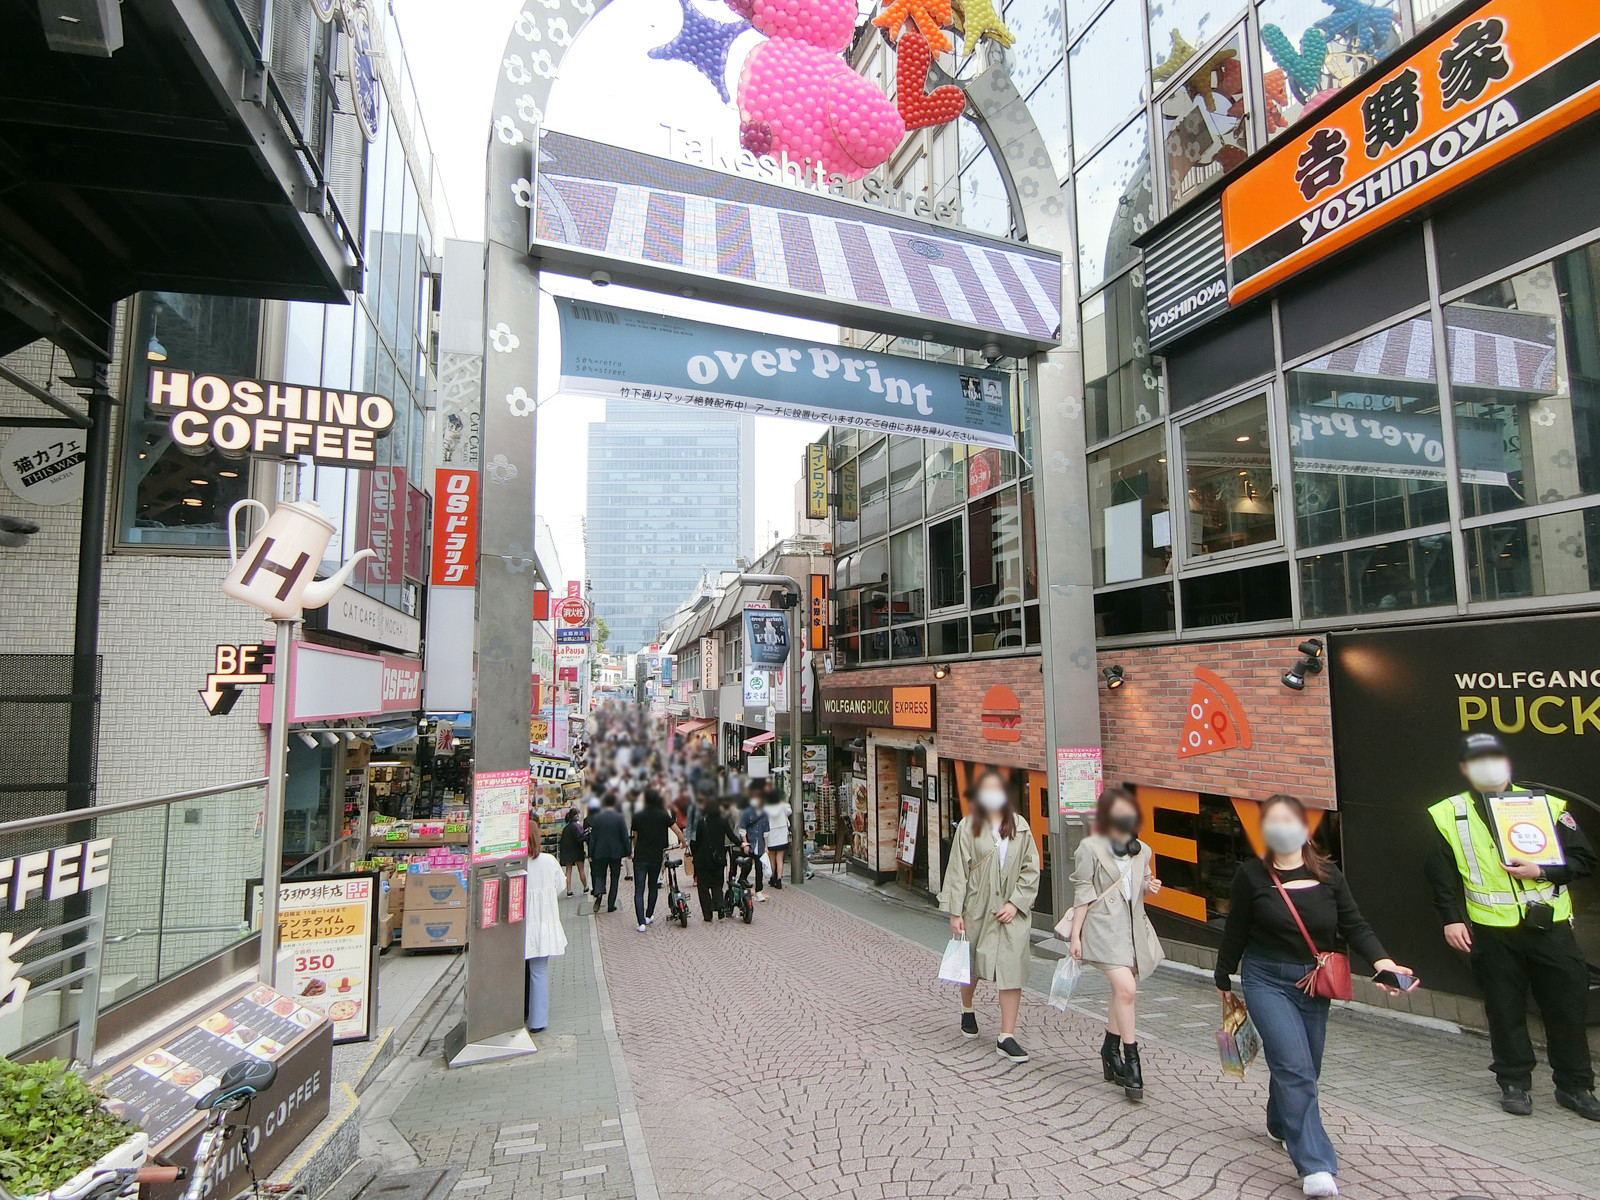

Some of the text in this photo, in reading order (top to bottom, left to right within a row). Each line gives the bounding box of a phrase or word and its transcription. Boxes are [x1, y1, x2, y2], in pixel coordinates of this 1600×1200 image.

[1294, 16, 1511, 203] 吉野家
[659, 122, 848, 197] Takeshita
[1300, 99, 1519, 245] YOSHINOYA
[1150, 279, 1226, 333] YOSHINOYA
[150, 370, 394, 429] HOSHINO
[687, 347, 801, 385] over
[807, 347, 934, 416] print
[171, 410, 375, 463] COFFEE
[469, 412, 480, 463] CAT CAFE
[13, 440, 80, 475] 猫カフェ
[24, 454, 80, 485] THIS WAY
[812, 445, 826, 508] コインロッカー
[443, 474, 470, 582] OSドラッグ
[241, 537, 311, 602] H
[342, 601, 358, 620] CAT
[360, 607, 376, 627] CAFE
[563, 607, 584, 618] 消火栓
[216, 645, 259, 675] BF
[566, 646, 585, 655] Pausa
[383, 667, 420, 700] OSドラッグ
[895, 701, 929, 714] EXPRESS
[1458, 695, 1600, 735] PUCK
[347, 881, 369, 893] BF
[279, 915, 344, 928] ランチタイム
[280, 925, 356, 940] ービスドリンク
[294, 954, 335, 972] 350
[265, 1070, 321, 1137] COFFEE
